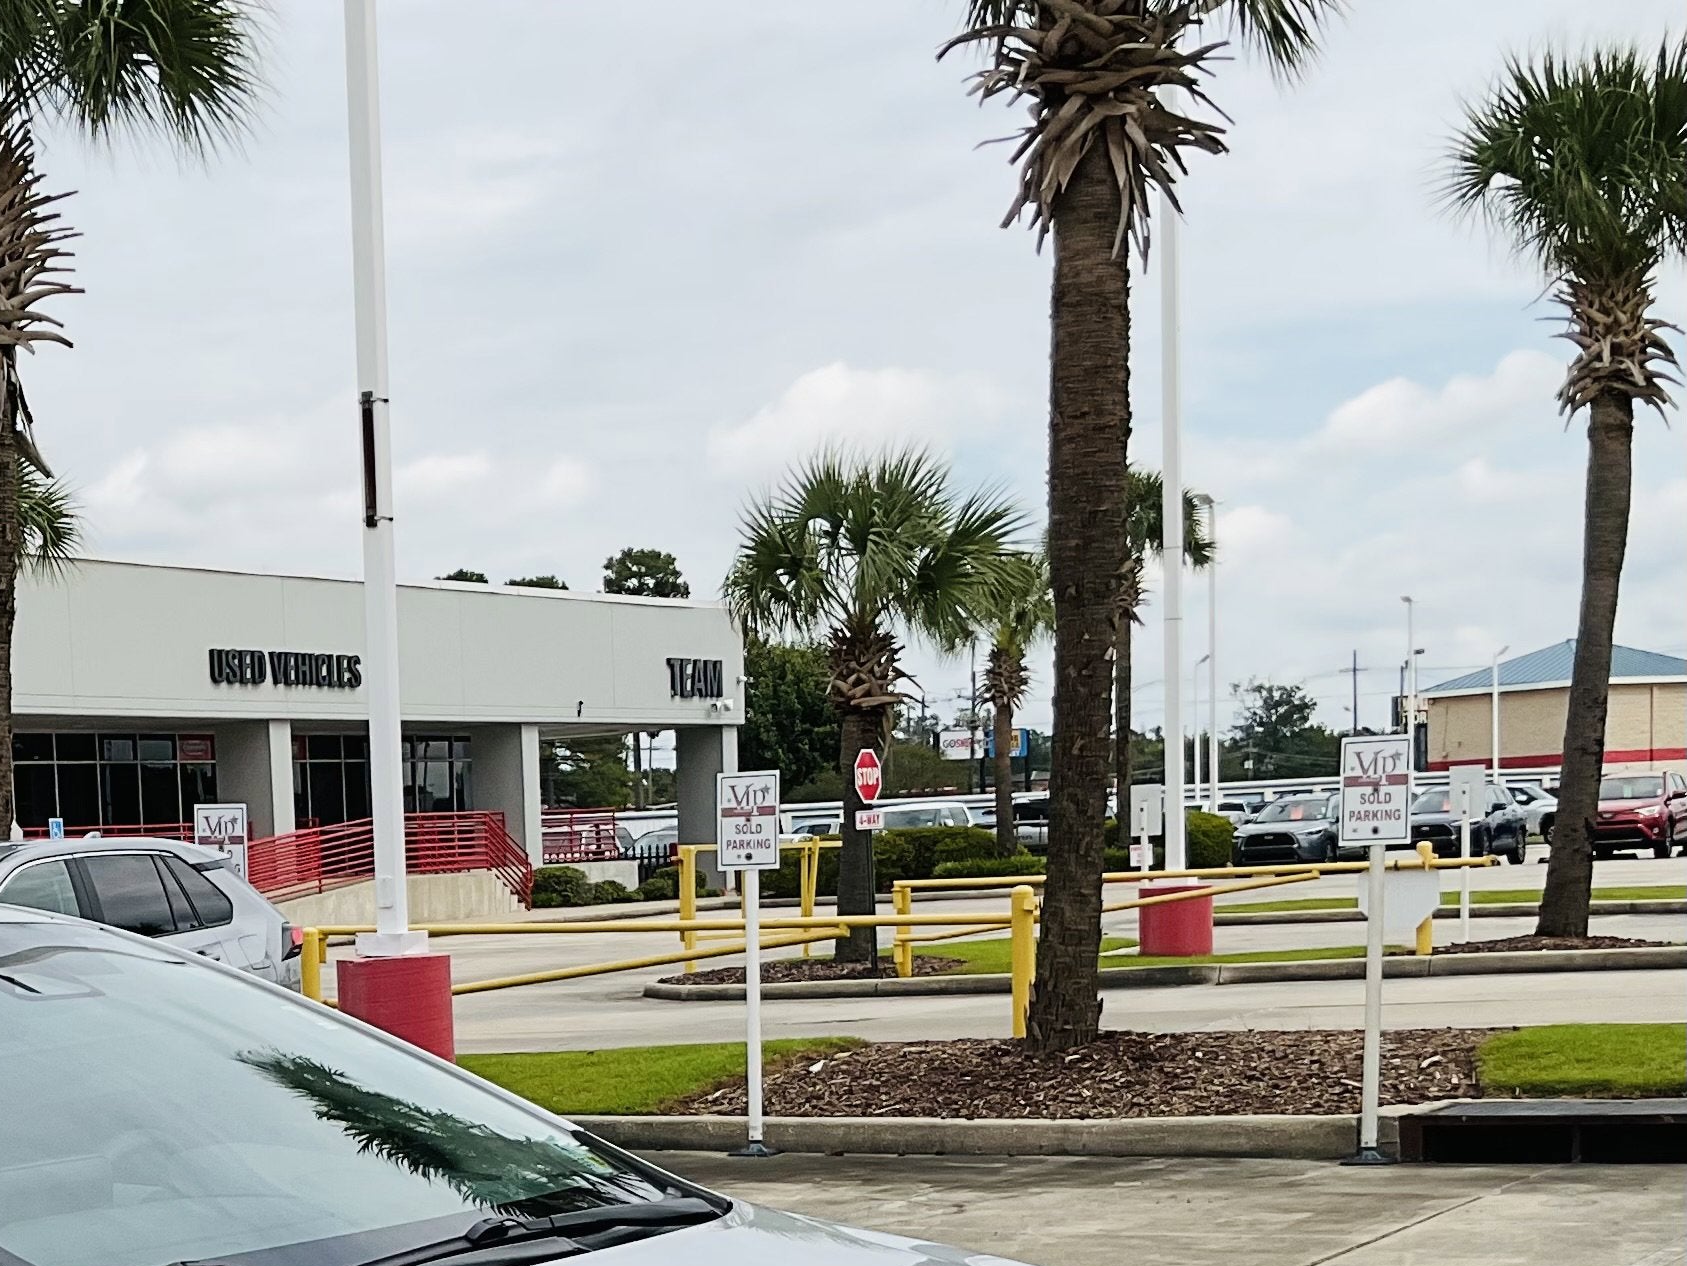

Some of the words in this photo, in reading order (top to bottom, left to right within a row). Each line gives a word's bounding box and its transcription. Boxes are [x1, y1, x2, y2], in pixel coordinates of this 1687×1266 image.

[209, 648, 267, 684] USED
[268, 651, 362, 688] VEHICLES
[666, 658, 723, 698] TEAM
[857, 767, 879, 786] STOP
[1359, 792, 1392, 804] SOLD
[859, 814, 880, 825] 4-WAY
[1348, 809, 1401, 822] PARKING
[734, 823, 762, 834] SOLD
[726, 838, 771, 850] PARKING
